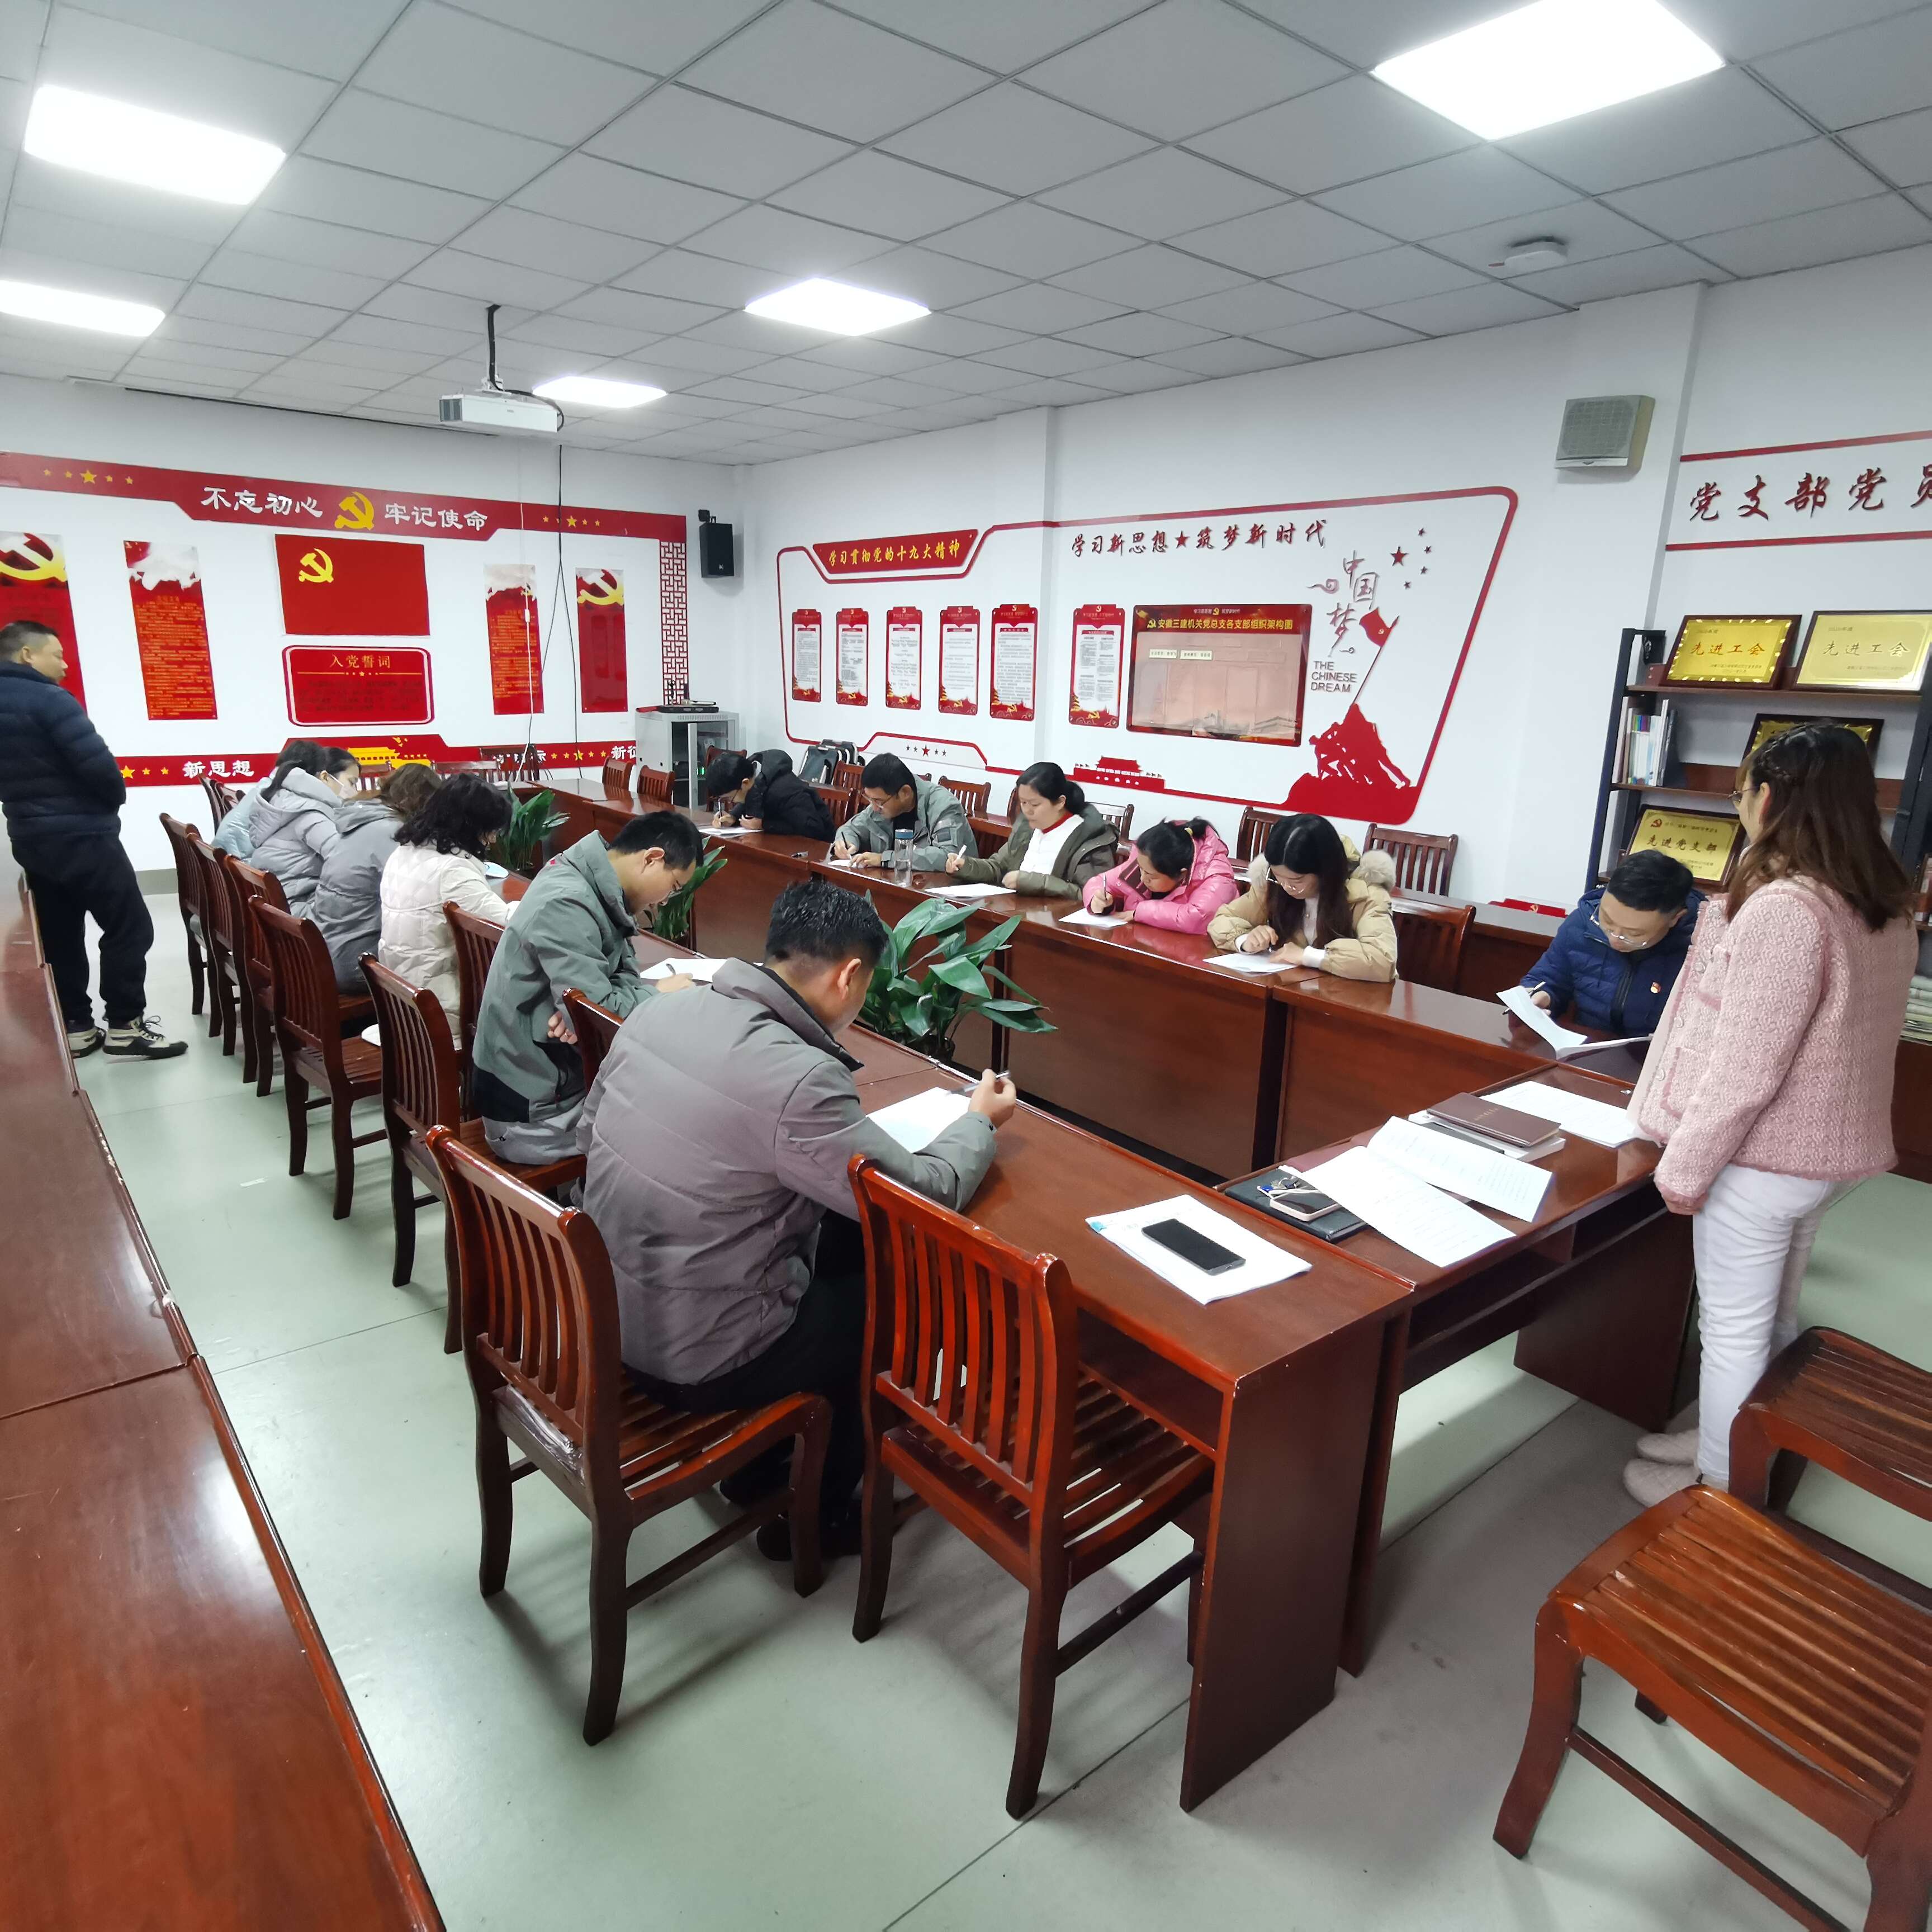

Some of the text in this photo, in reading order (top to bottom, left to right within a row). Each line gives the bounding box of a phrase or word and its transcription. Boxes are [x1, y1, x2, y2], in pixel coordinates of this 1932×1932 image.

[1689, 463, 1932, 521] 党支部党员
[201, 486, 488, 532] 不忘初心 牢记使命
[1071, 519, 1328, 557] 学习新思想 筑梦新时代
[828, 538, 960, 567] 学习贯彻党的十九大精神
[1158, 618, 1293, 630] 安徽三建机关党总支各支部组织架构图
[1689, 641, 1765, 656] 先进工会
[1822, 640, 1909, 656] 先进工会
[329, 654, 391, 669] 入党誓词
[1314, 661, 1335, 671] THE
[1311, 671, 1357, 683] CHINESE
[1310, 681, 1351, 693] DREAM
[182, 760, 255, 779] 新思想
[1646, 834, 1718, 855] 先进党支部
